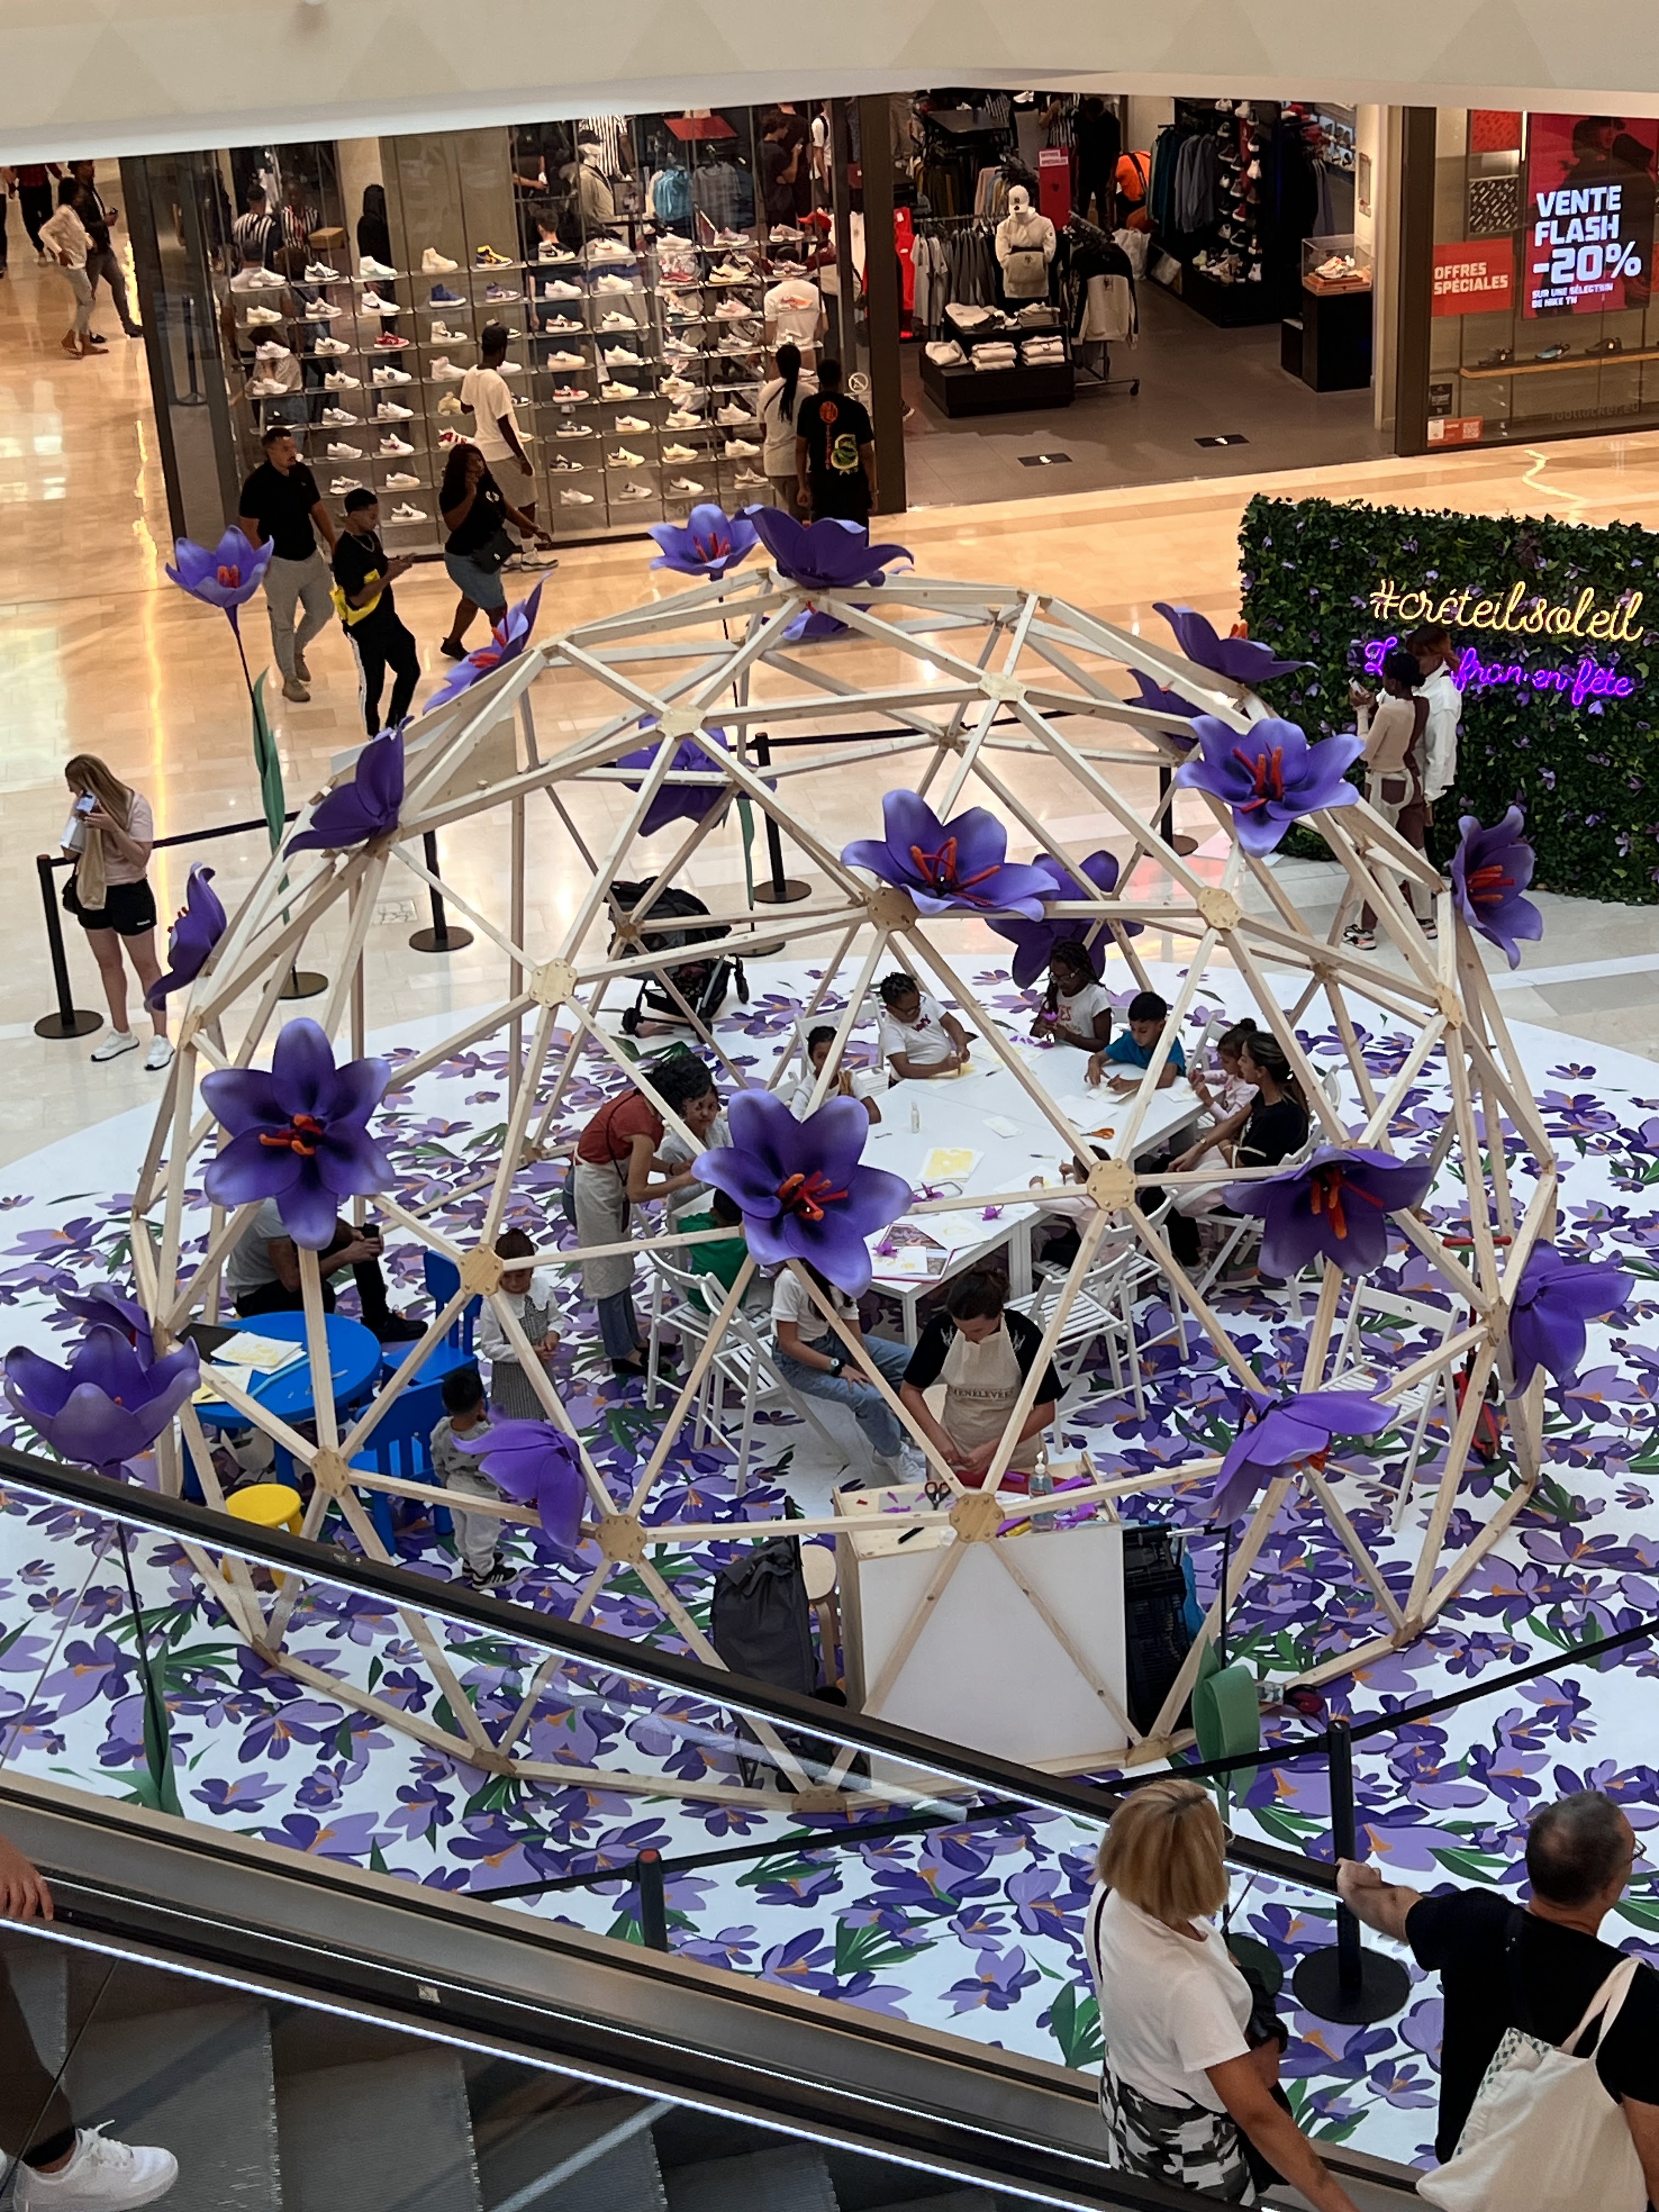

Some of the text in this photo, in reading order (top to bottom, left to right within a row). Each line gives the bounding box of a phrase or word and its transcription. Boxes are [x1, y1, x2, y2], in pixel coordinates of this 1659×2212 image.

[1537, 185, 1622, 217] VENTE
[1535, 214, 1620, 246] FLASH
[1434, 262, 1487, 280] OFFRES
[1533, 241, 1641, 284] -20%
[1434, 275, 1508, 295] SPÉCIALES
[1370, 579, 1644, 641] #créteilsoleil
[1571, 659, 1633, 706] fête
